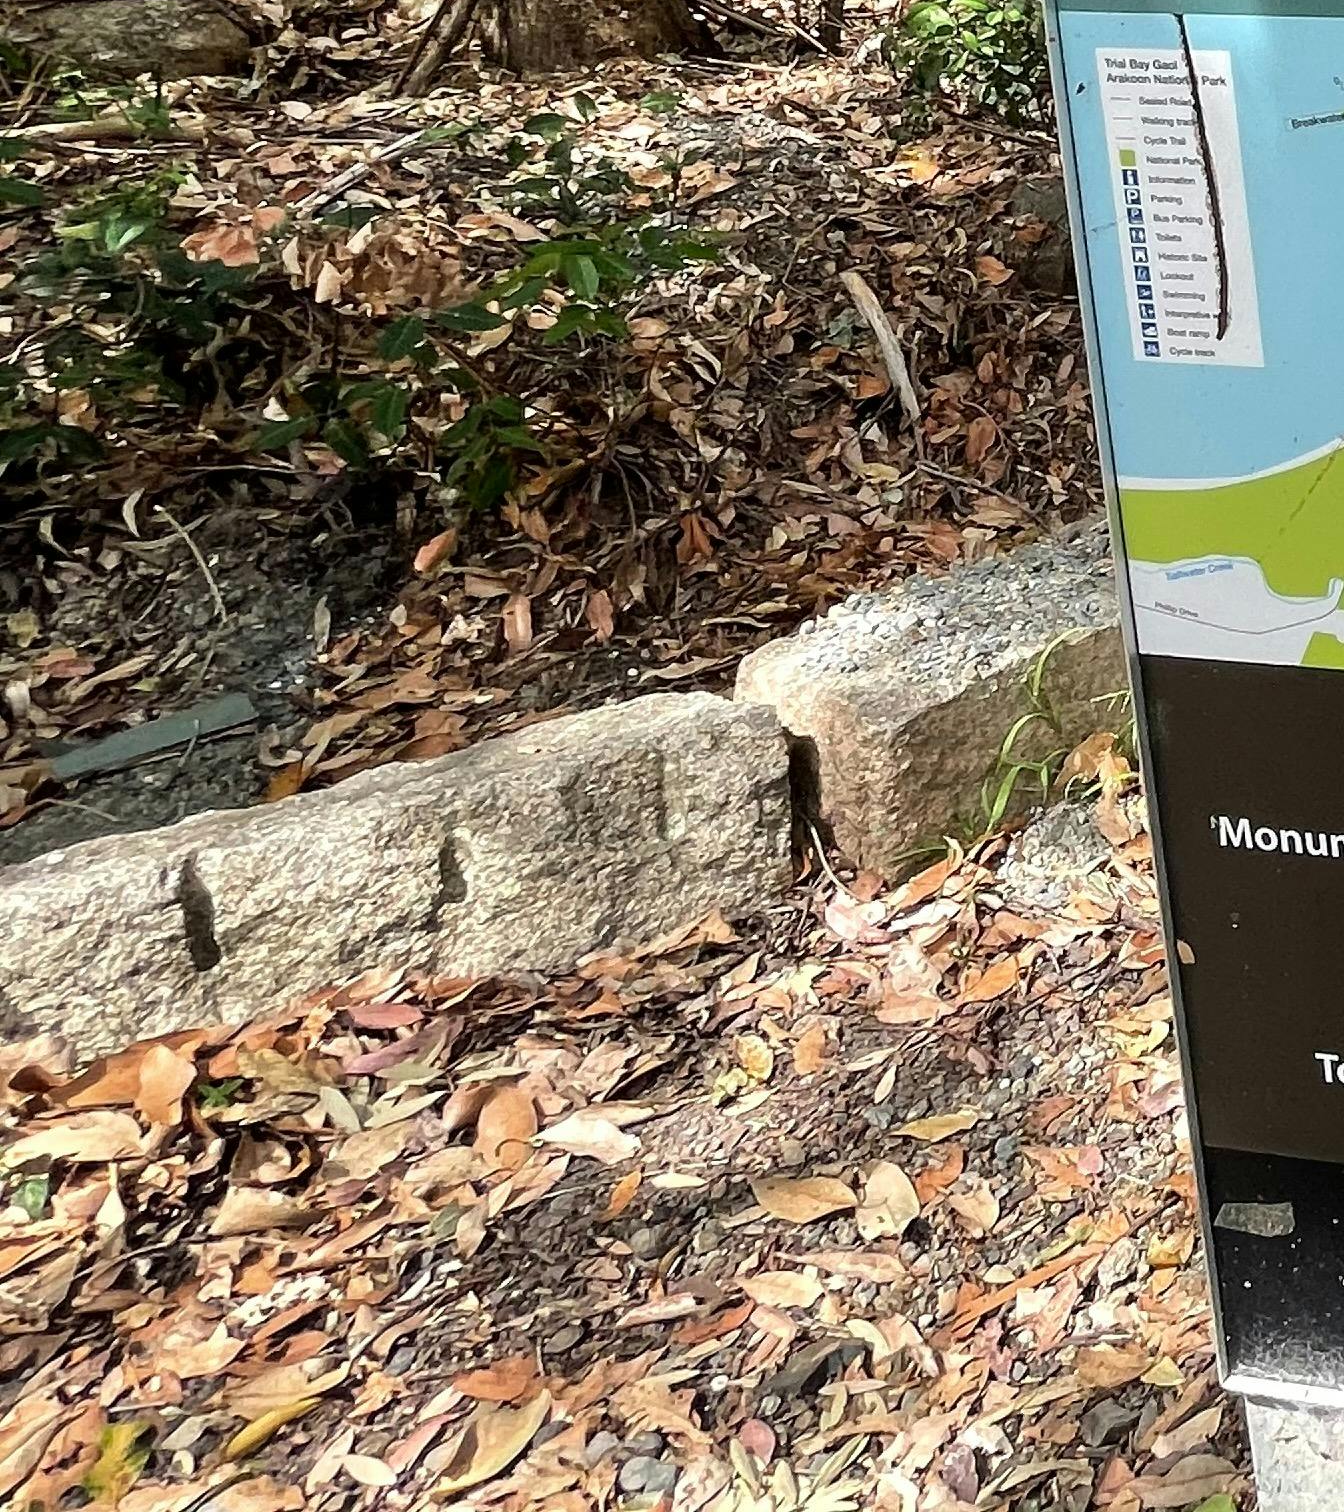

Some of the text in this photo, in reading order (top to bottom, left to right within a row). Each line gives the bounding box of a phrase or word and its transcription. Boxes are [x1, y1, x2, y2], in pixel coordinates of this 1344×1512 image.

[1105, 58, 1126, 69] Trial
[1129, 59, 1150, 71] Bay
[1201, 75, 1227, 86] Park
[1146, 156, 1180, 165] National
[1148, 176, 1196, 185] Information
[1151, 194, 1183, 206] Parking
[1172, 215, 1203, 226] Parking
